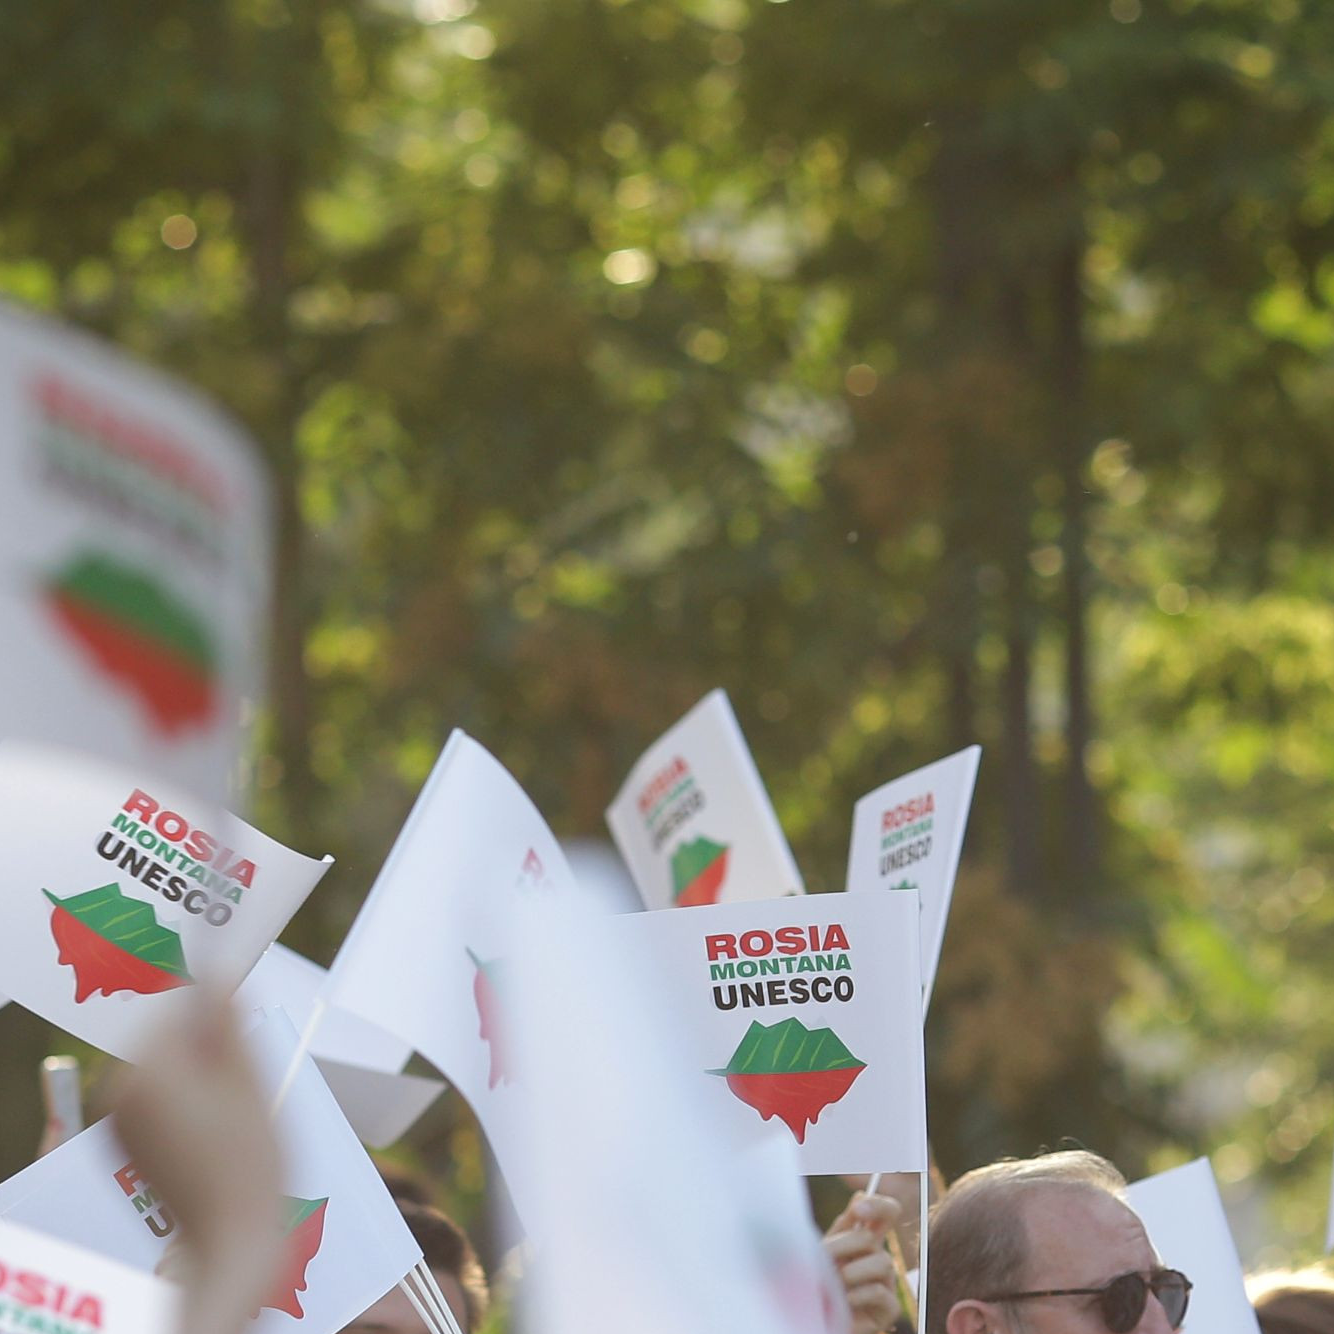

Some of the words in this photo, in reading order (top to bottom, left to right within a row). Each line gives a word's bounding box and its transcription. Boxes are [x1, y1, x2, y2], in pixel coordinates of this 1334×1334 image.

[882, 791, 934, 833] ROSIA
[111, 814, 243, 904] MONTANA
[122, 788, 257, 889] ROSIA
[880, 835, 932, 876] UNESCO
[96, 832, 233, 926] UNESCO
[705, 924, 850, 961] ROSIA
[710, 954, 851, 981] MONTANA
[713, 976, 854, 1010] UNESCO
